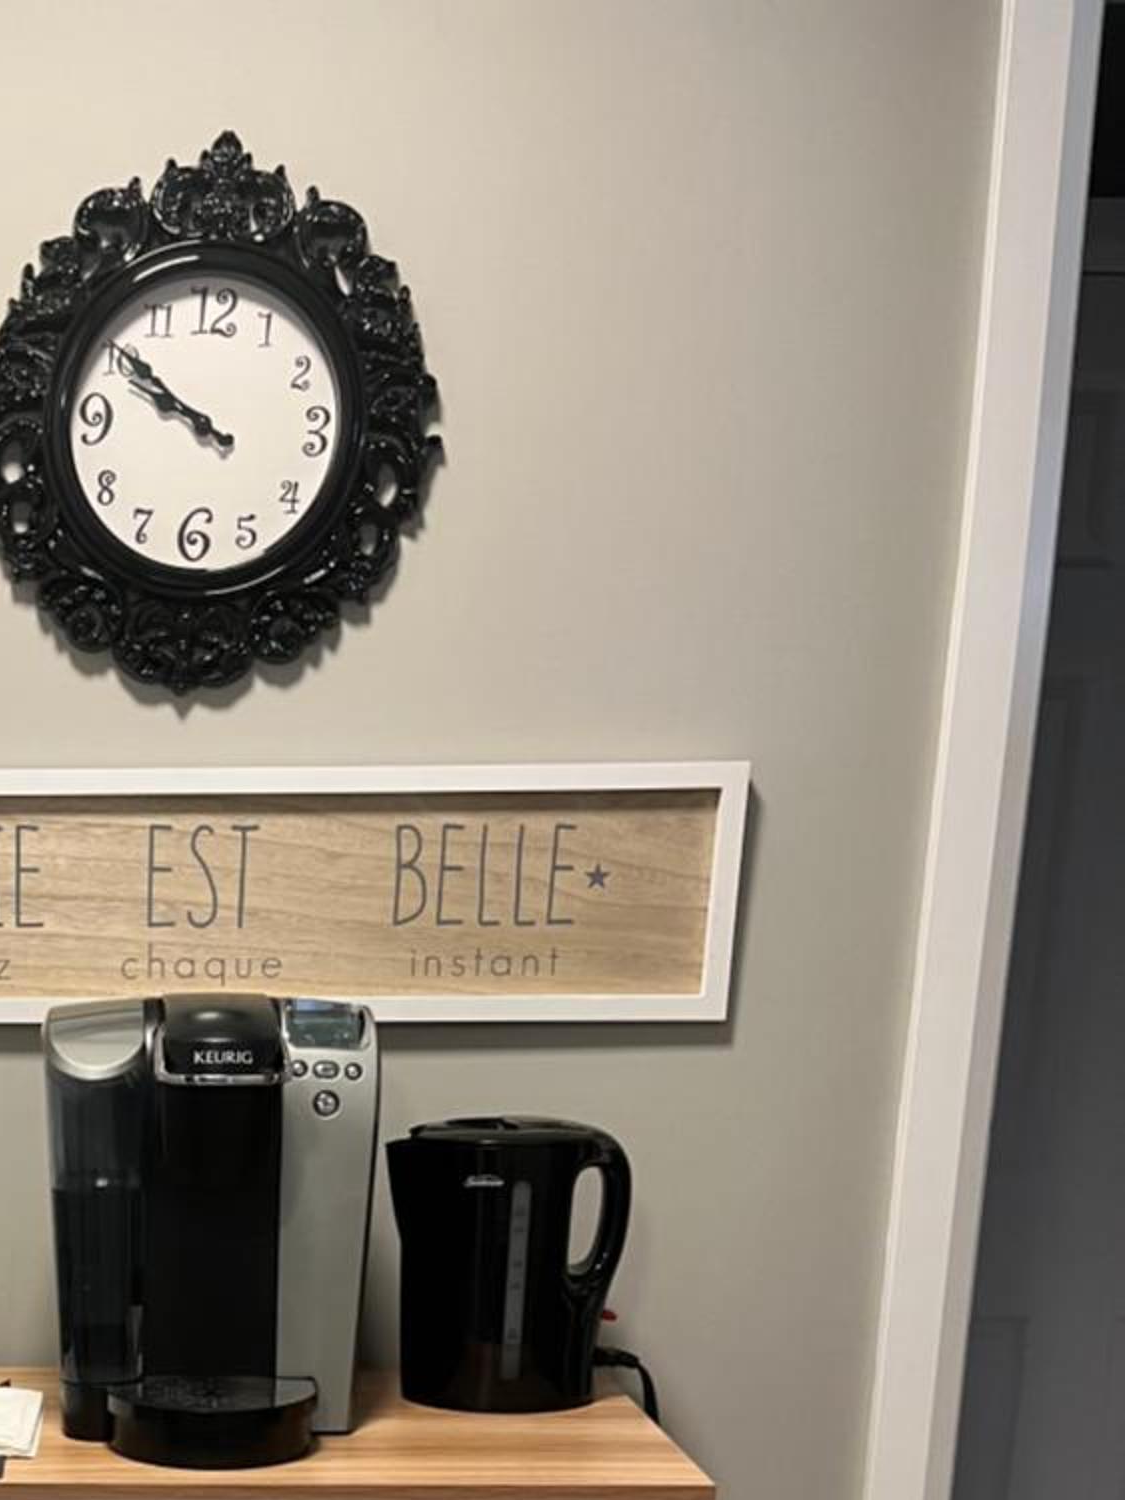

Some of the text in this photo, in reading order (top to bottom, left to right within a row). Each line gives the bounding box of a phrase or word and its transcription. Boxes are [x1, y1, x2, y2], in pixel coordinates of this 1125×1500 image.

[143, 304, 173, 338] 11
[190, 286, 238, 338] 12
[257, 311, 273, 348] 1
[290, 355, 312, 391] 2
[79, 392, 114, 446] 9
[301, 405, 331, 457] 3
[96, 469, 117, 506] 8
[278, 480, 300, 514] 4
[132, 507, 154, 544] 7
[177, 506, 214, 562] 6
[235, 513, 257, 549] 5
[145, 823, 261, 930] EST
[391, 823, 578, 928] BELLE
[120, 942, 285, 988] chaque
[409, 947, 561, 979] instant
[193, 1049, 254, 1065] KEURIG
